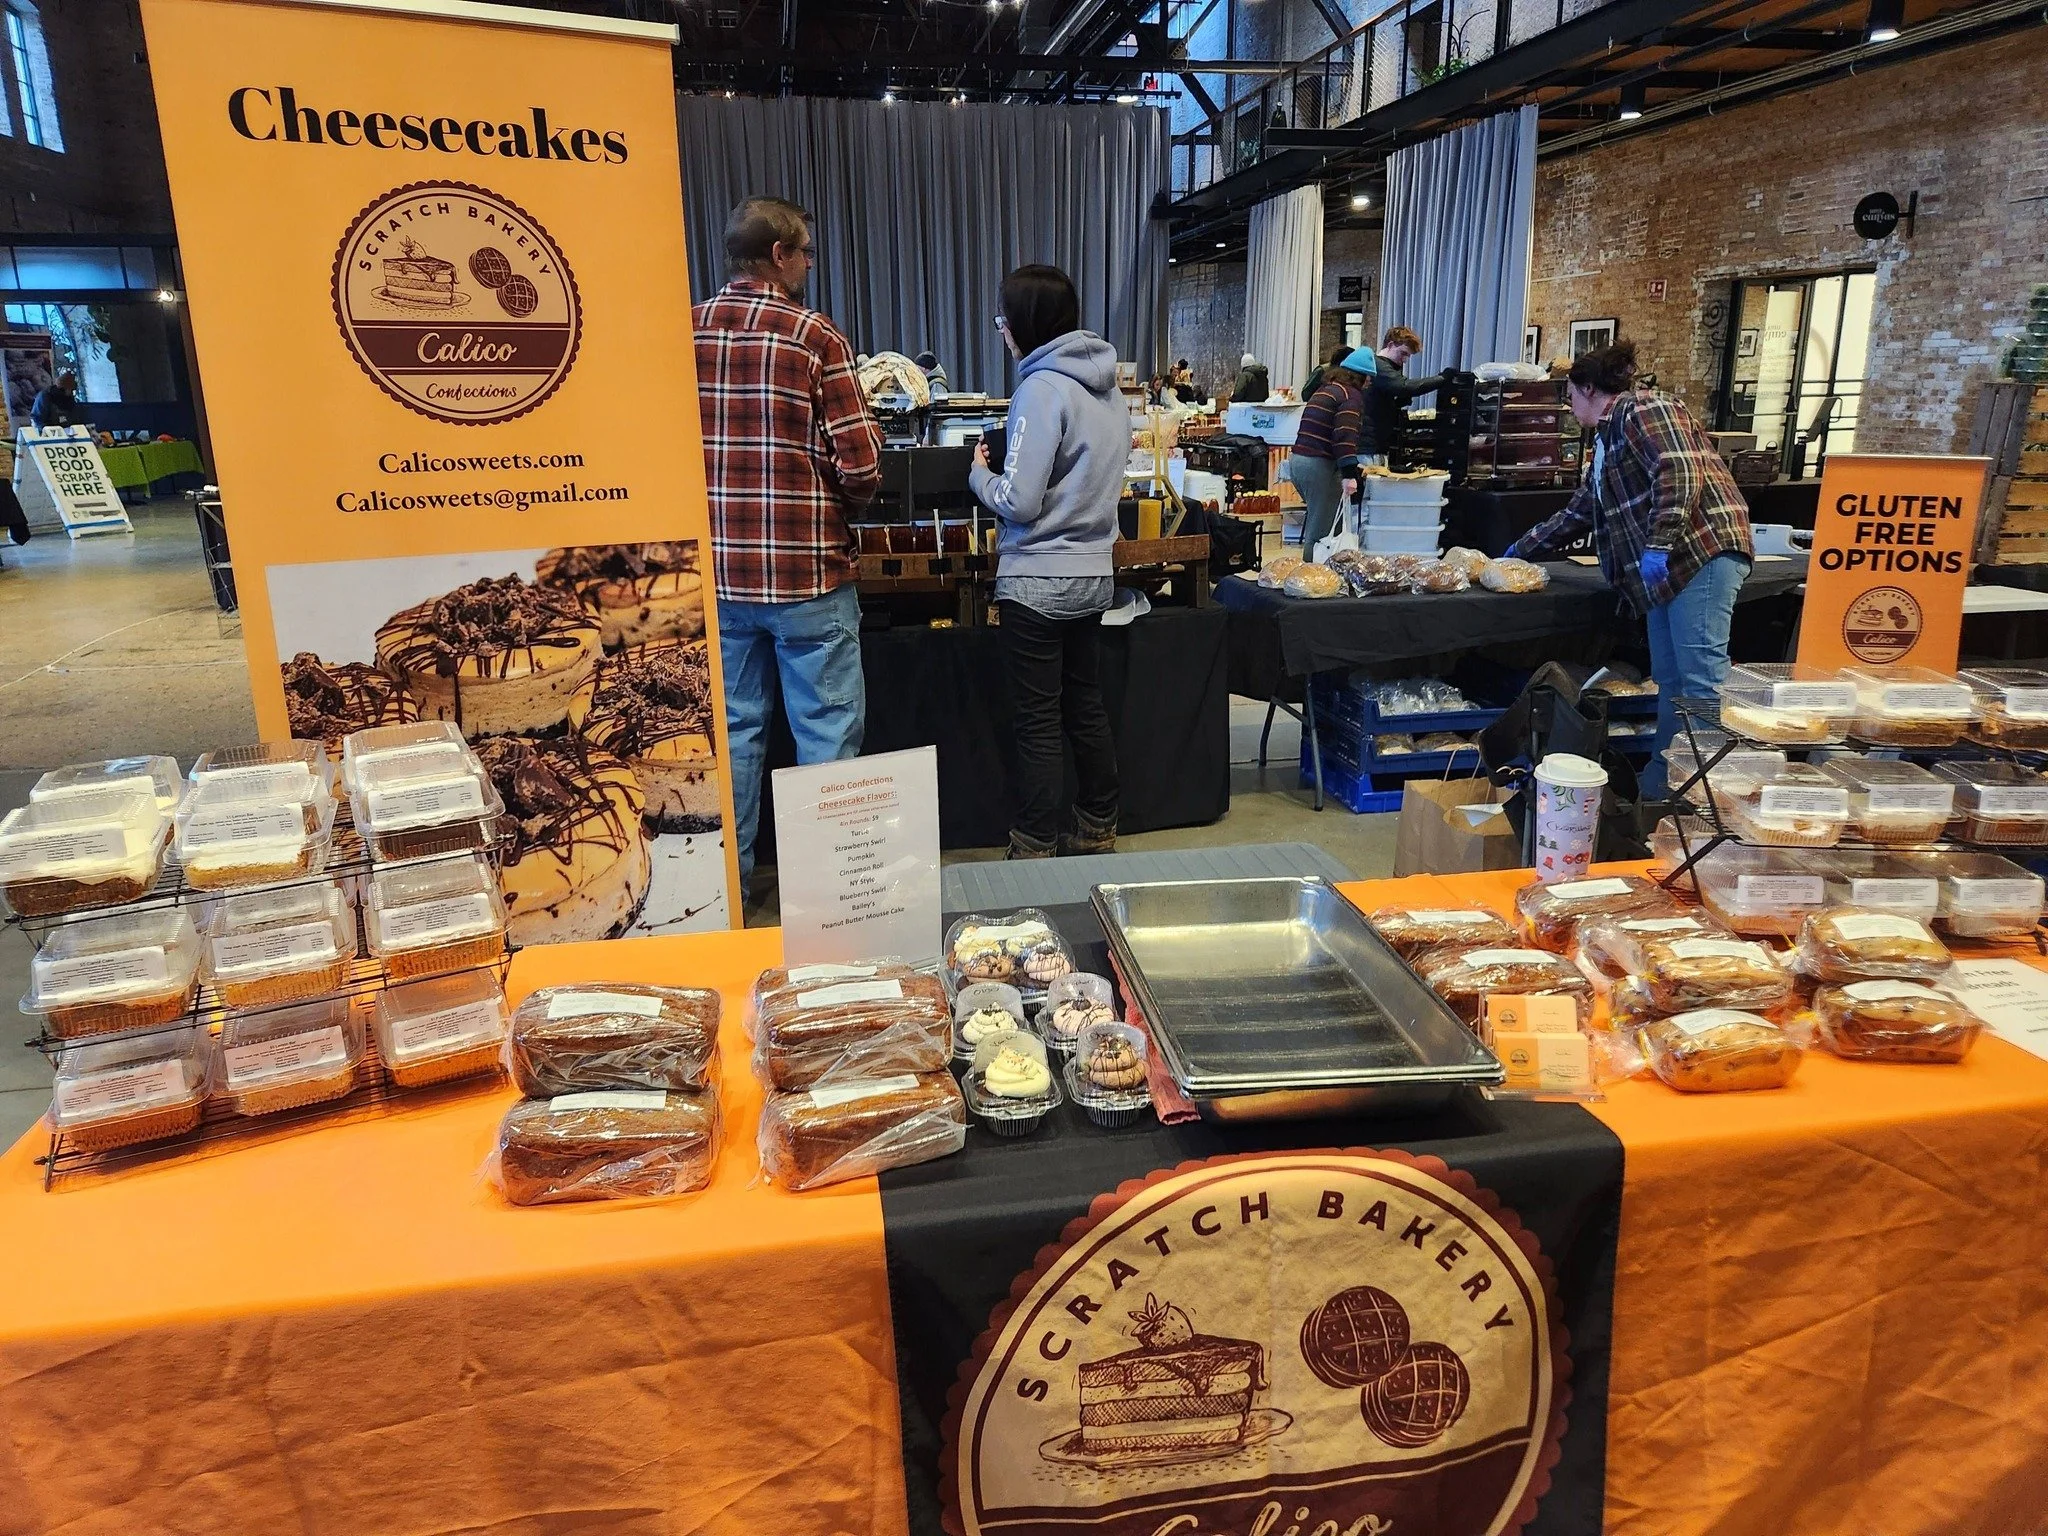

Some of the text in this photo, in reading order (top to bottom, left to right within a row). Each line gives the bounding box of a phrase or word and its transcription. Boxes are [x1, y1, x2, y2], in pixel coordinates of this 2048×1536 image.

[228, 86, 629, 165] Cheesecakes
[359, 203, 552, 277] SCRATCH BAKERY
[416, 332, 517, 364] Calico
[426, 383, 517, 401] Confections
[44, 446, 88, 460] DROP
[50, 459, 94, 472] FOOD
[378, 452, 585, 474] Calicosweets.com
[55, 472, 100, 483] SCRAPS
[60, 482, 106, 496] HERE
[335, 482, 630, 514] Calicosweets@gmail.com
[1835, 493, 1963, 519] GLUTEN
[1854, 522, 1936, 546] FREE
[1818, 548, 1963, 574] OPTIONS
[1863, 633, 1898, 644] Calico
[821, 776, 893, 793] Calico Confections
[818, 790, 898, 810] Cheesecake Flavors:
[872, 814, 880, 822] $9
[834, 837, 886, 853] Strawberry Swirl
[848, 852, 875, 863] Pumpkin
[840, 862, 884, 877] Cinnamon Roll
[840, 886, 887, 901] Blueberry Swirl
[852, 901, 875, 911] Bailey's
[821, 907, 905, 930] Peanut Butter Mousse Cake
[1016, 1190, 1514, 1402] SCRATCH BAKERY
